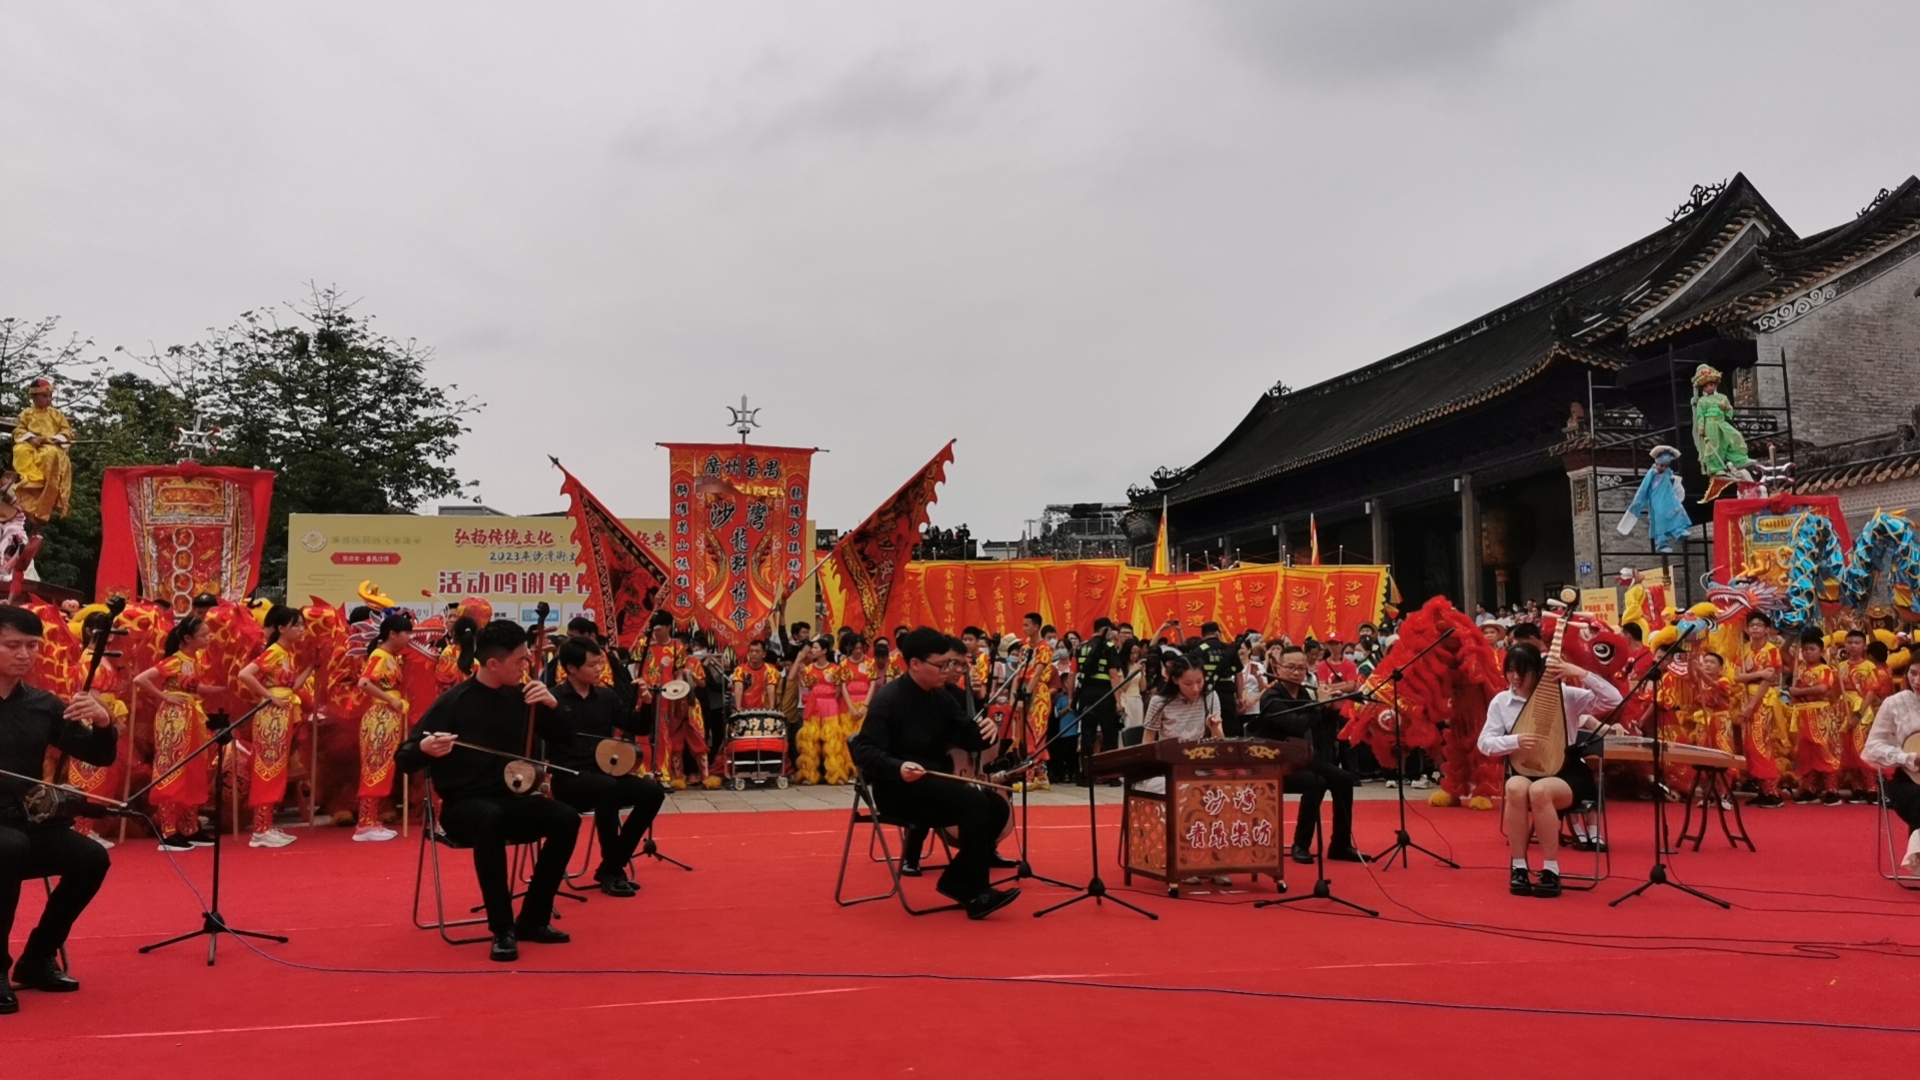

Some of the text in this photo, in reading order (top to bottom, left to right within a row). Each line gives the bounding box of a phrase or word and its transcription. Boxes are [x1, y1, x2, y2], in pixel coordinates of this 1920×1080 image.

[703, 454, 780, 480] 廣州番禺
[709, 500, 769, 532] 沙灣
